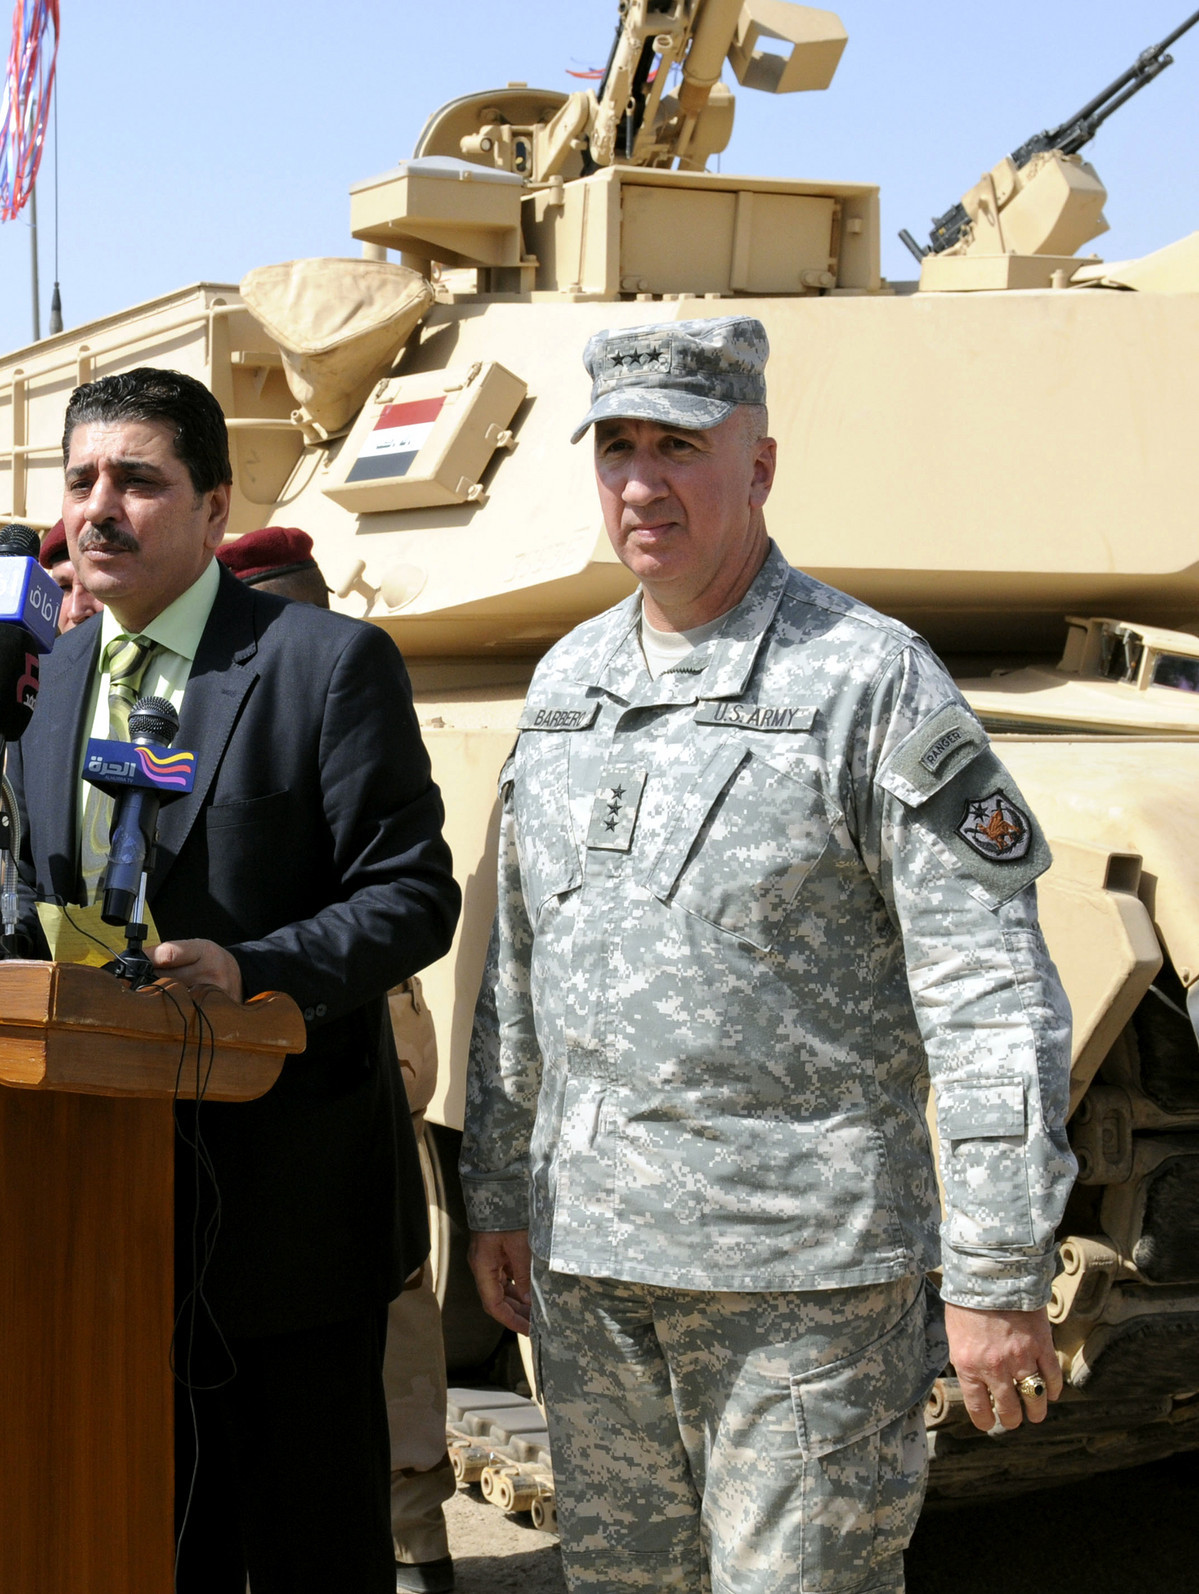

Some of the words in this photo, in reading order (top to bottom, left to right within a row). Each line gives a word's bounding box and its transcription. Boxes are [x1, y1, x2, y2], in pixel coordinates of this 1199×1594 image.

[713, 704, 744, 723] U.S.
[747, 706, 800, 728] ARMY
[926, 731, 962, 765] RANGER
[88, 756, 137, 778] الحرة
